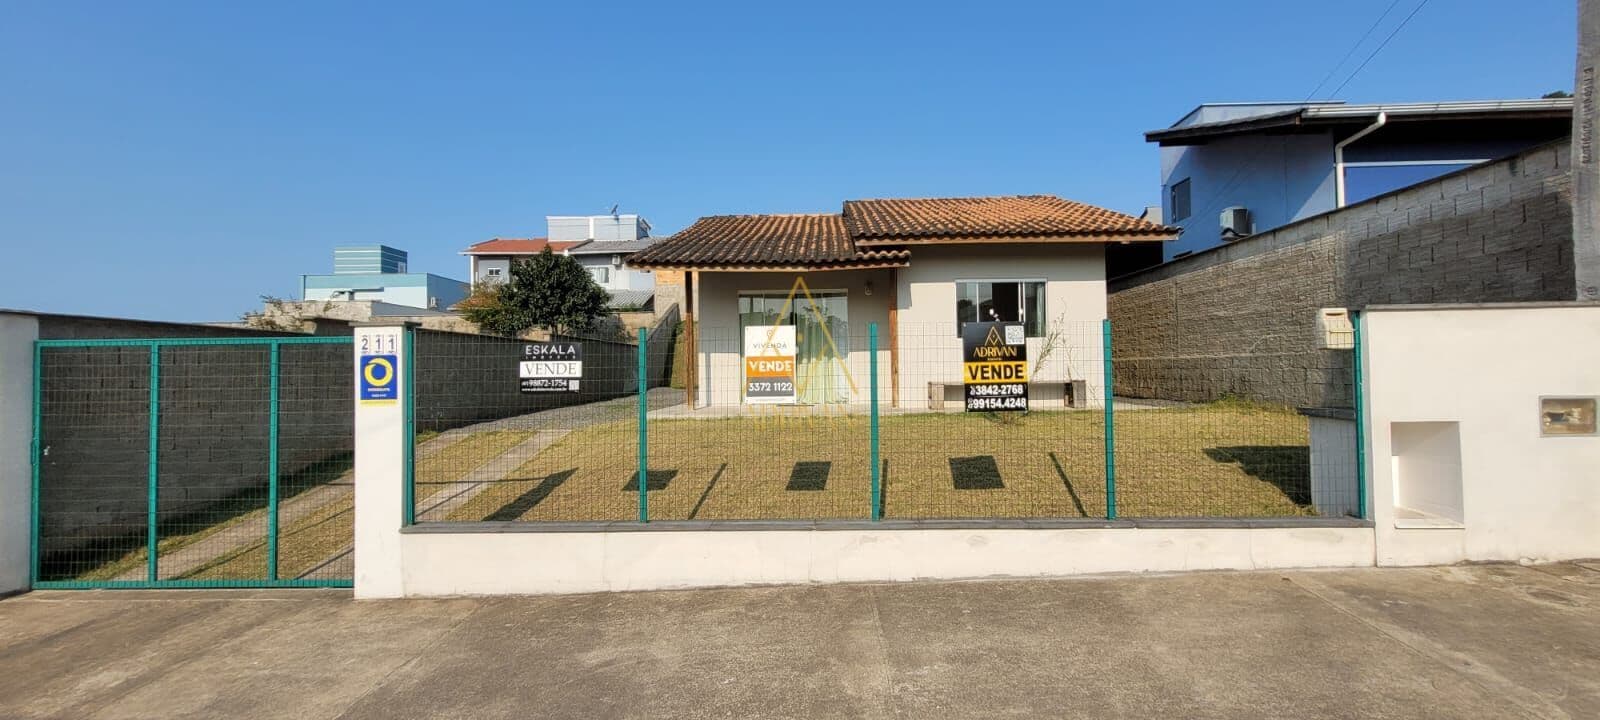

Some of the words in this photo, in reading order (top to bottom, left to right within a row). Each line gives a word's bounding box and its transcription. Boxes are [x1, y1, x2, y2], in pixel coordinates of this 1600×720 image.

[361, 337, 395, 351] 211
[525, 344, 576, 355] ESKALA
[525, 362, 577, 375] VENDE
[749, 360, 793, 373] VENDE
[968, 364, 1025, 380] VENDE
[748, 382, 772, 392] 3372
[773, 382, 793, 392] 1122
[975, 384, 1024, 396] 3842-2768
[973, 397, 1027, 409] 99154.4248
